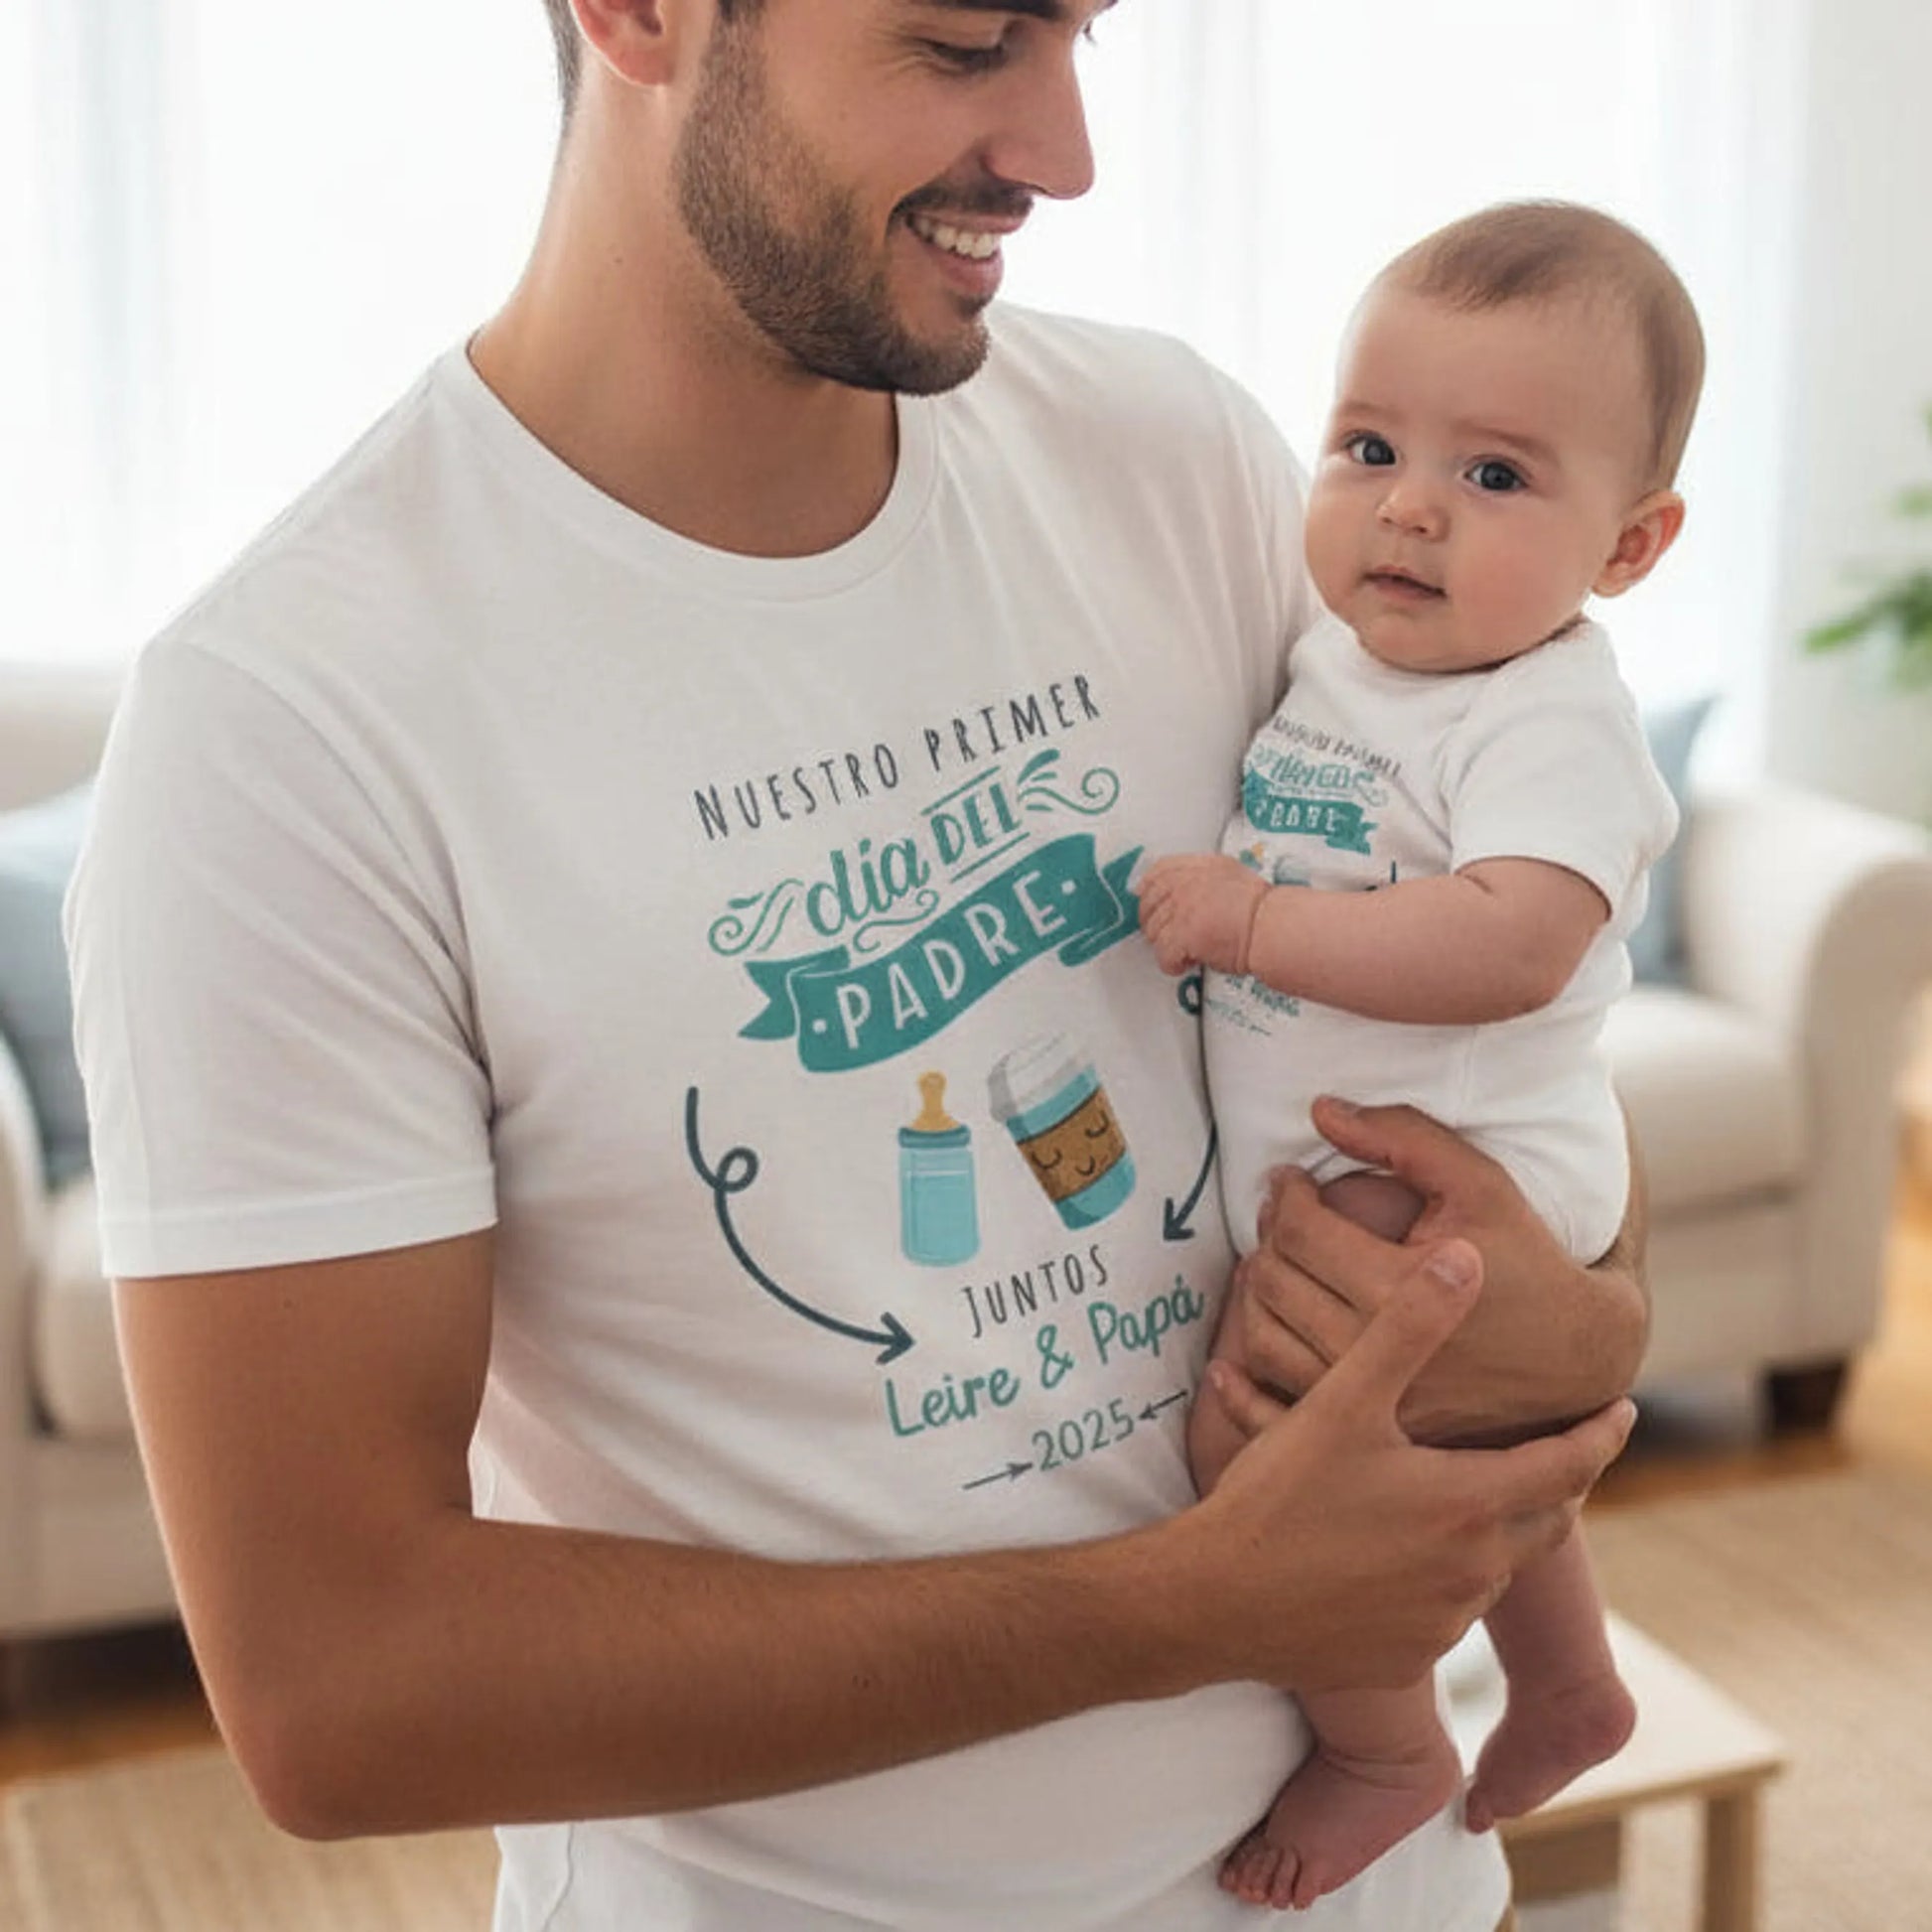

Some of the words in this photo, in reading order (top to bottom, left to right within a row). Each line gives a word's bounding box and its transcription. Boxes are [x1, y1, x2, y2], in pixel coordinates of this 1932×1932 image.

[695, 743, 899, 841] NUESTRO
[923, 674, 1101, 771] PRIMER
[928, 782, 1024, 867] DEL
[835, 870, 1067, 1049] PADRE
[885, 1367, 1022, 1438] Leire
[1035, 1323, 1075, 1390] &
[1087, 1273, 1205, 1365] Papá
[961, 1243, 1109, 1339] JUNTOS
[1031, 1397, 1136, 1472] 2025
